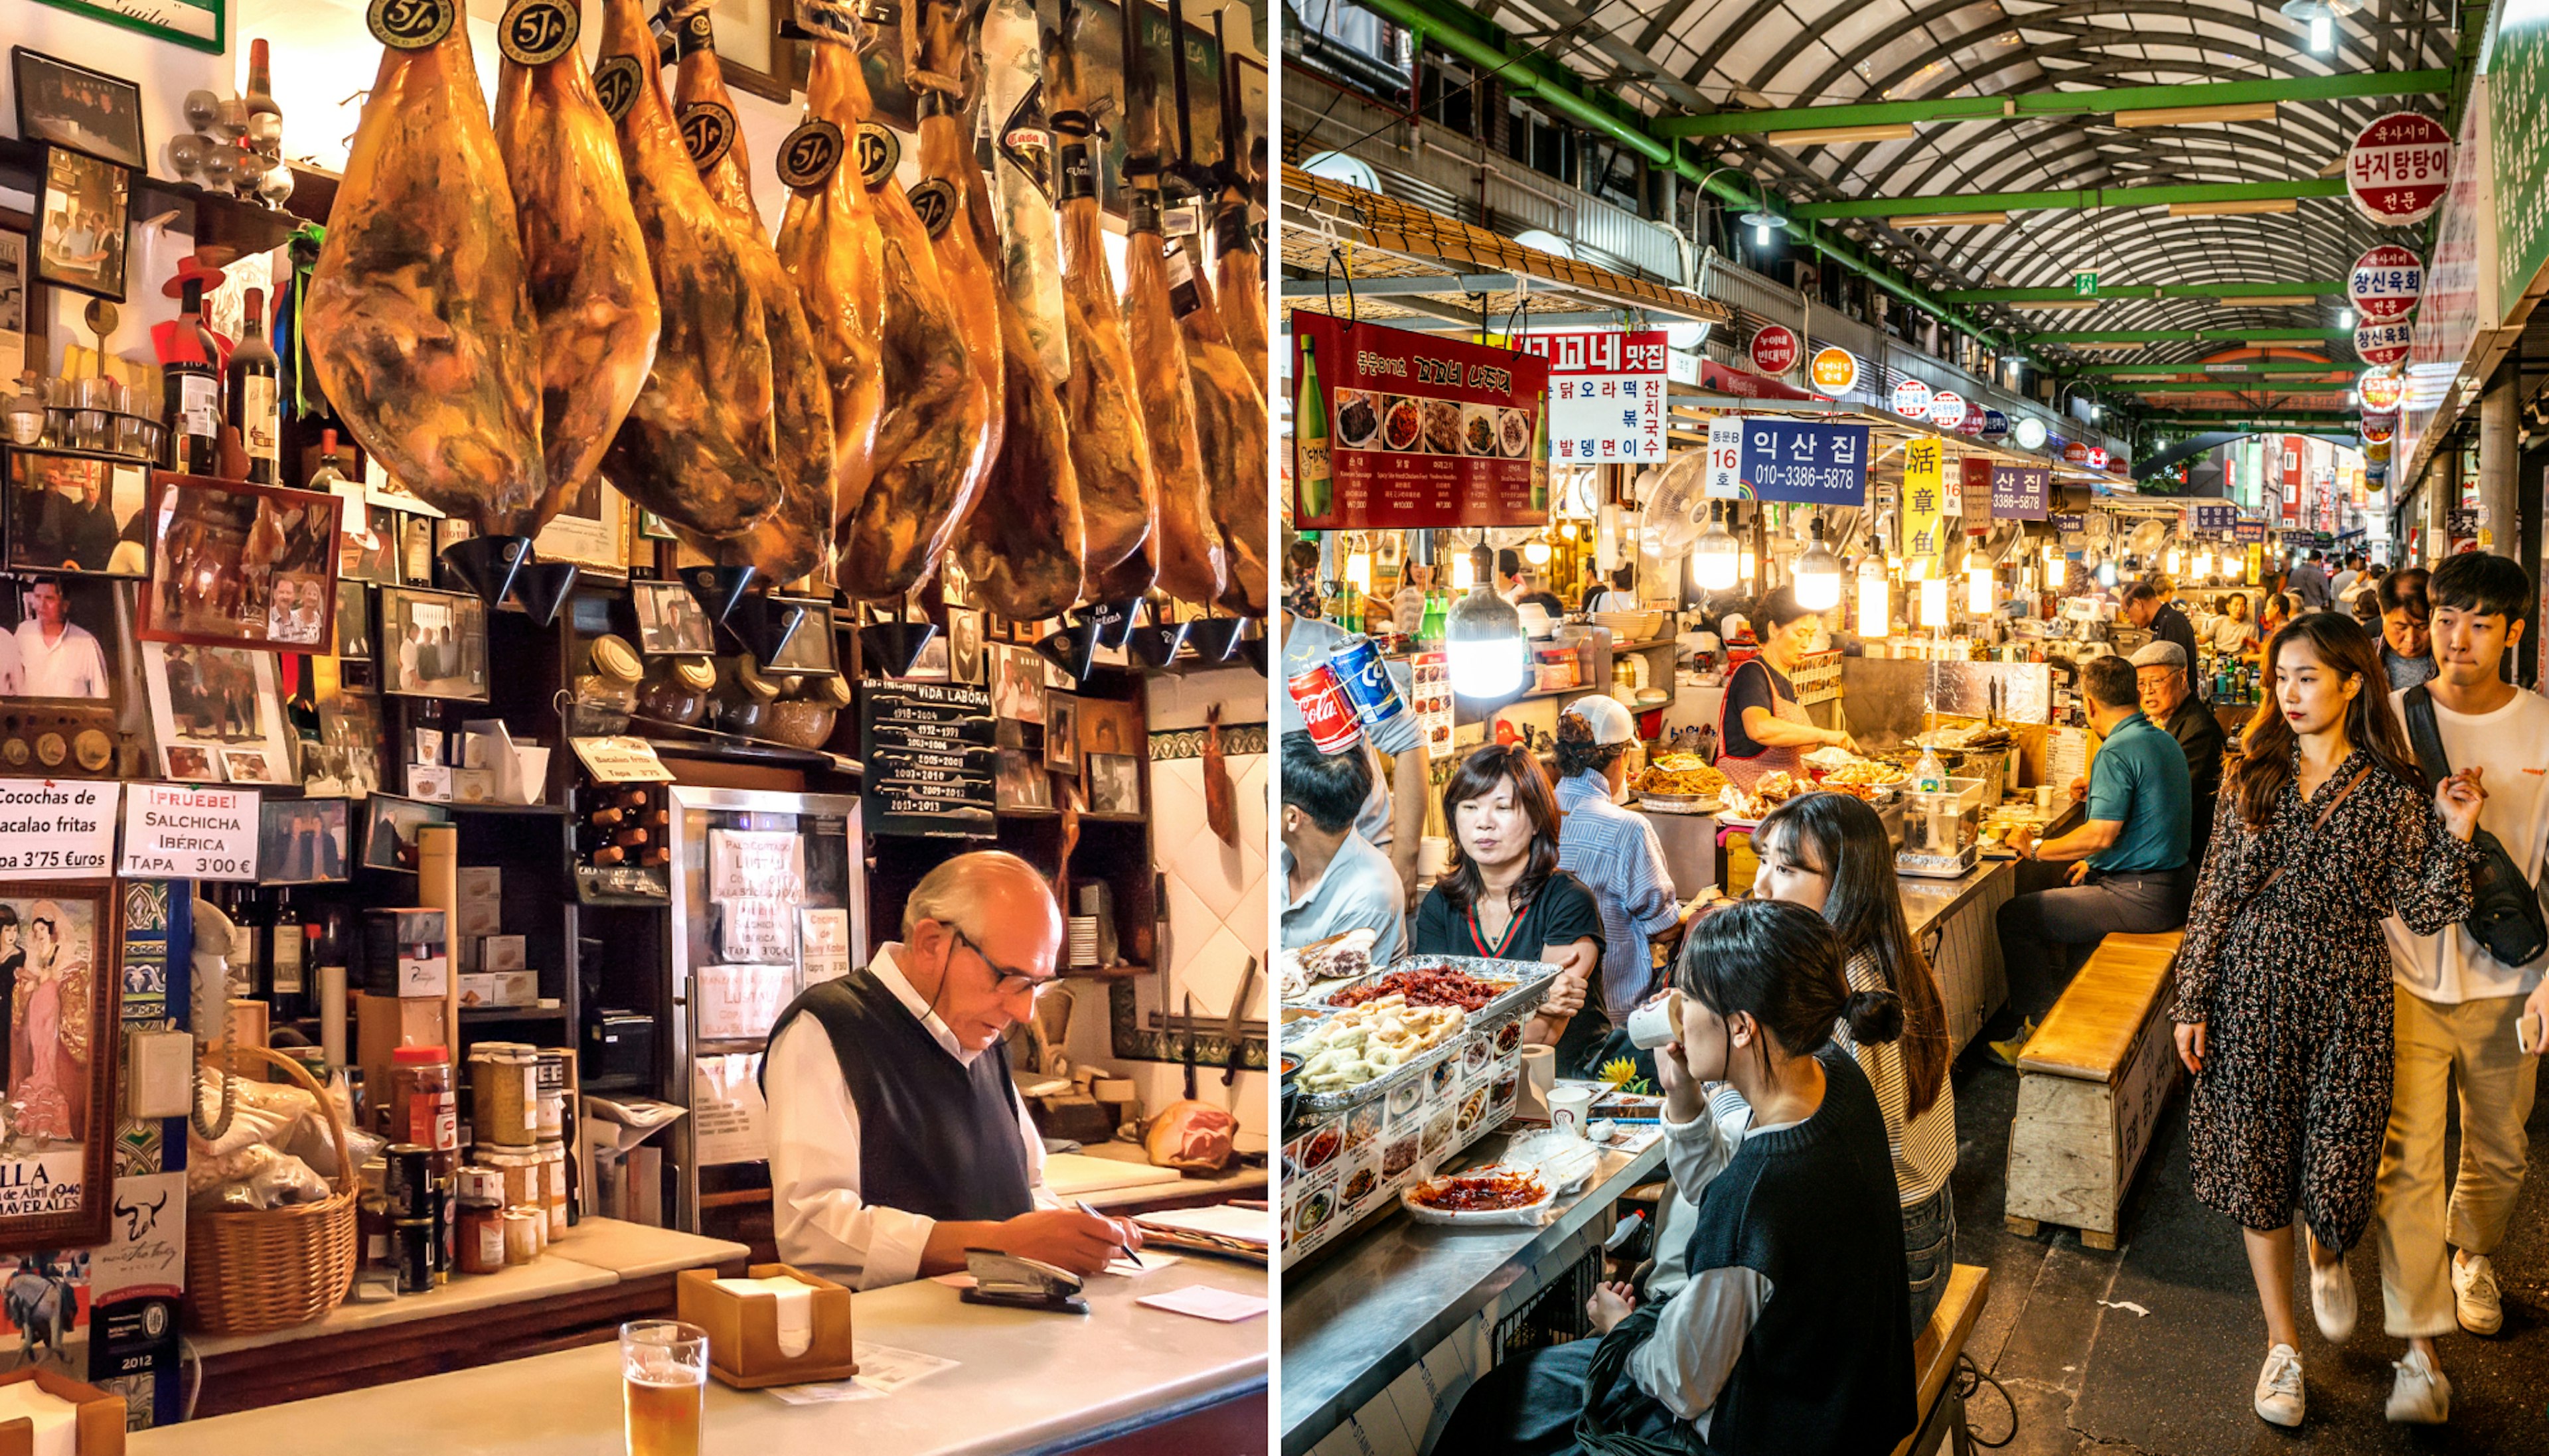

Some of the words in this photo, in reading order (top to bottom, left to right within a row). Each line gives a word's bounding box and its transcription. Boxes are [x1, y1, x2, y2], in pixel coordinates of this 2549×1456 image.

[518, 9, 555, 50] 5J
[1007, 133, 1039, 146] Casa
[792, 137, 823, 173] 5J
[2354, 148, 2449, 182] 낙지탕탕이
[2383, 191, 2416, 211] 전문
[2354, 270, 2421, 293] 창신육회
[2373, 300, 2398, 314] 전문
[1626, 344, 1665, 370] 맛집
[1713, 449, 1737, 469] 16
[1716, 472, 1730, 486] 호
[1755, 463, 1854, 490] 010-3386-5878
[1944, 483, 1961, 496] 16
[74, 788, 96, 804] de
[56, 816, 96, 833] fritas
[240, 860, 250, 874] €
[805, 963, 824, 973] Tapa
[4, 1189, 18, 1200] de
[122, 1354, 153, 1370] 2012
